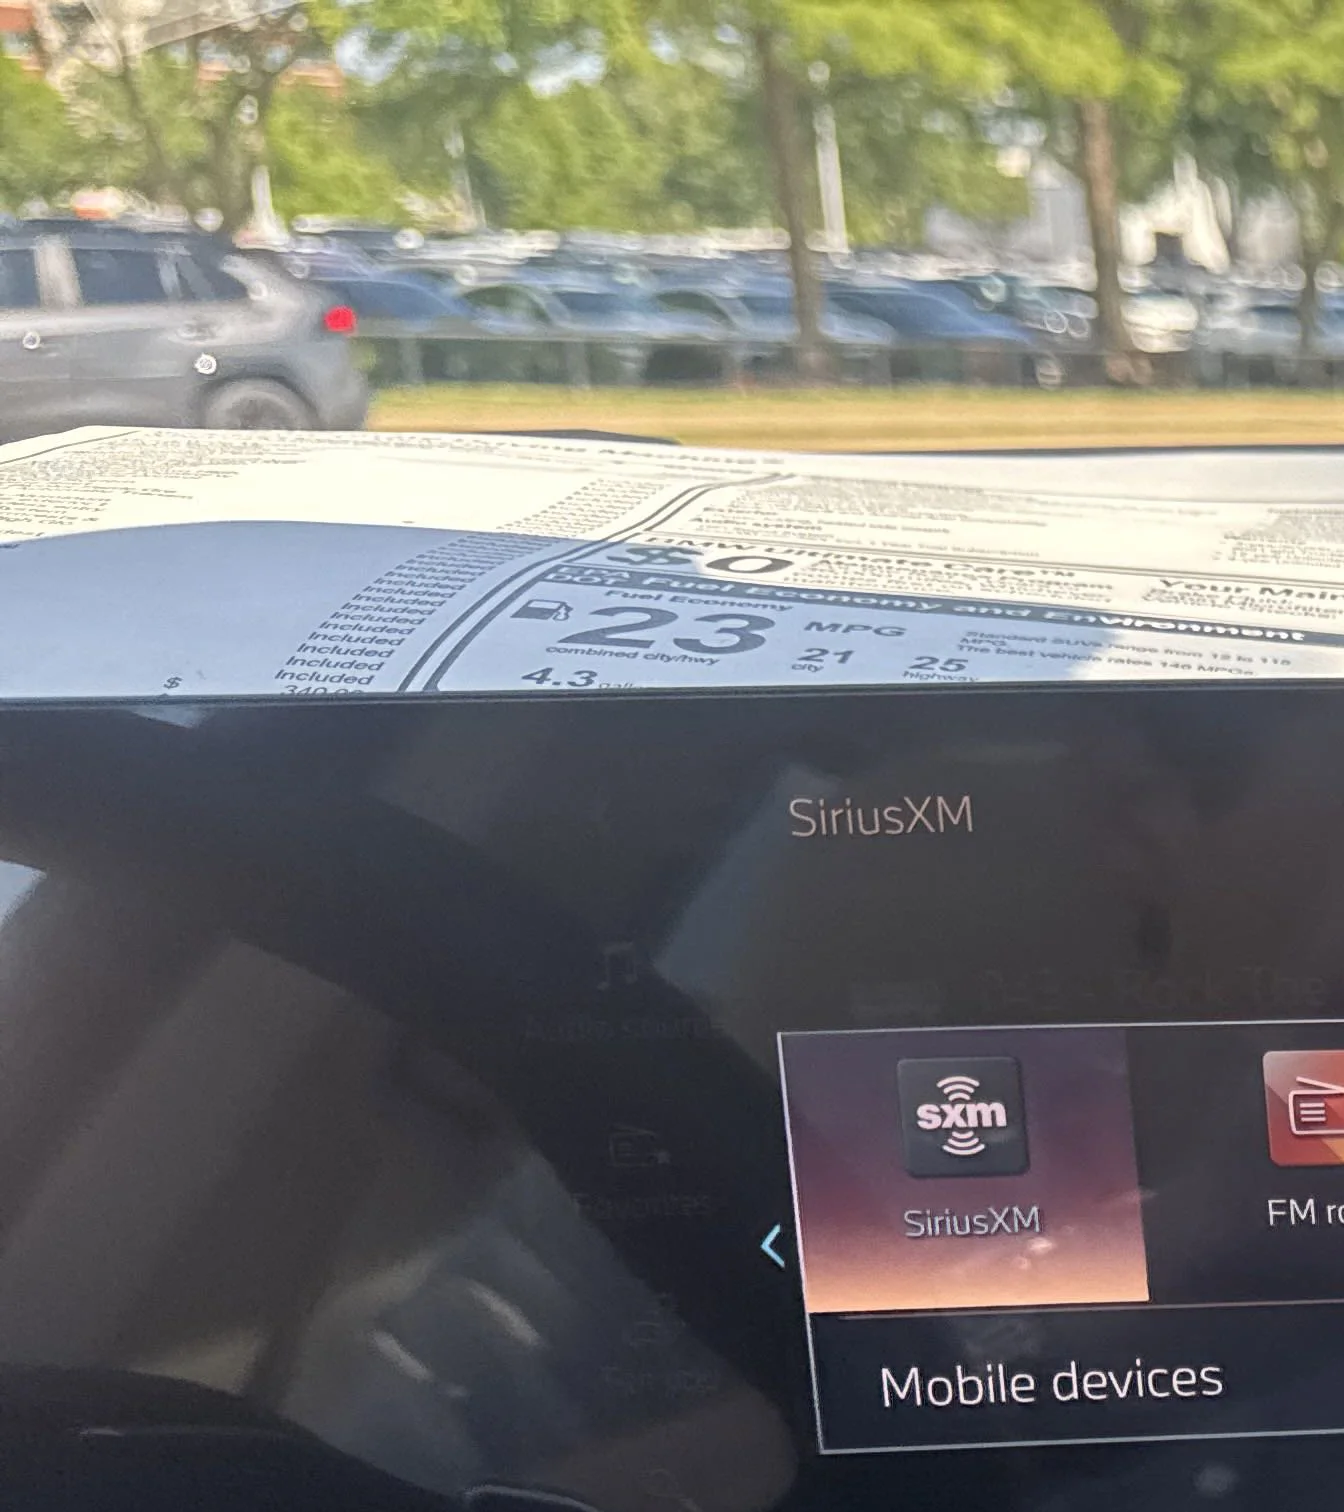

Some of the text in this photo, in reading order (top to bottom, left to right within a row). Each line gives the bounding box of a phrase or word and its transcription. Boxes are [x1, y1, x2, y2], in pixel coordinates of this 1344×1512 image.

[372, 577, 467, 591] Included
[384, 570, 477, 583] Included
[361, 585, 457, 599] Included
[1160, 577, 1251, 595] Your
[340, 602, 437, 616] Included
[351, 593, 447, 608] Included
[604, 589, 794, 612] Fuel Economy
[643, 576, 736, 593] Fuel
[745, 586, 943, 612] Economy
[953, 604, 1031, 618] and
[1043, 610, 1305, 641] Environment
[330, 611, 427, 626] Included
[318, 620, 416, 636] Included
[557, 605, 776, 655] 23
[804, 620, 907, 638] MPG
[307, 631, 406, 647] Included
[296, 642, 396, 659] Included
[545, 644, 721, 667] combined city/hwy
[797, 647, 855, 665] 21
[285, 655, 385, 672] Included
[791, 661, 825, 674] city
[907, 655, 968, 673] 25
[163, 676, 183, 690] $
[274, 668, 376, 686] Included
[521, 666, 598, 688] 4.3
[902, 669, 980, 683] highway
[788, 794, 974, 838] SiriusXM
[916, 1100, 1008, 1131] sxm
[1266, 1197, 1317, 1227] FM
[903, 1204, 1041, 1240] SiriusXM
[881, 1357, 1224, 1409] Mobile devices
